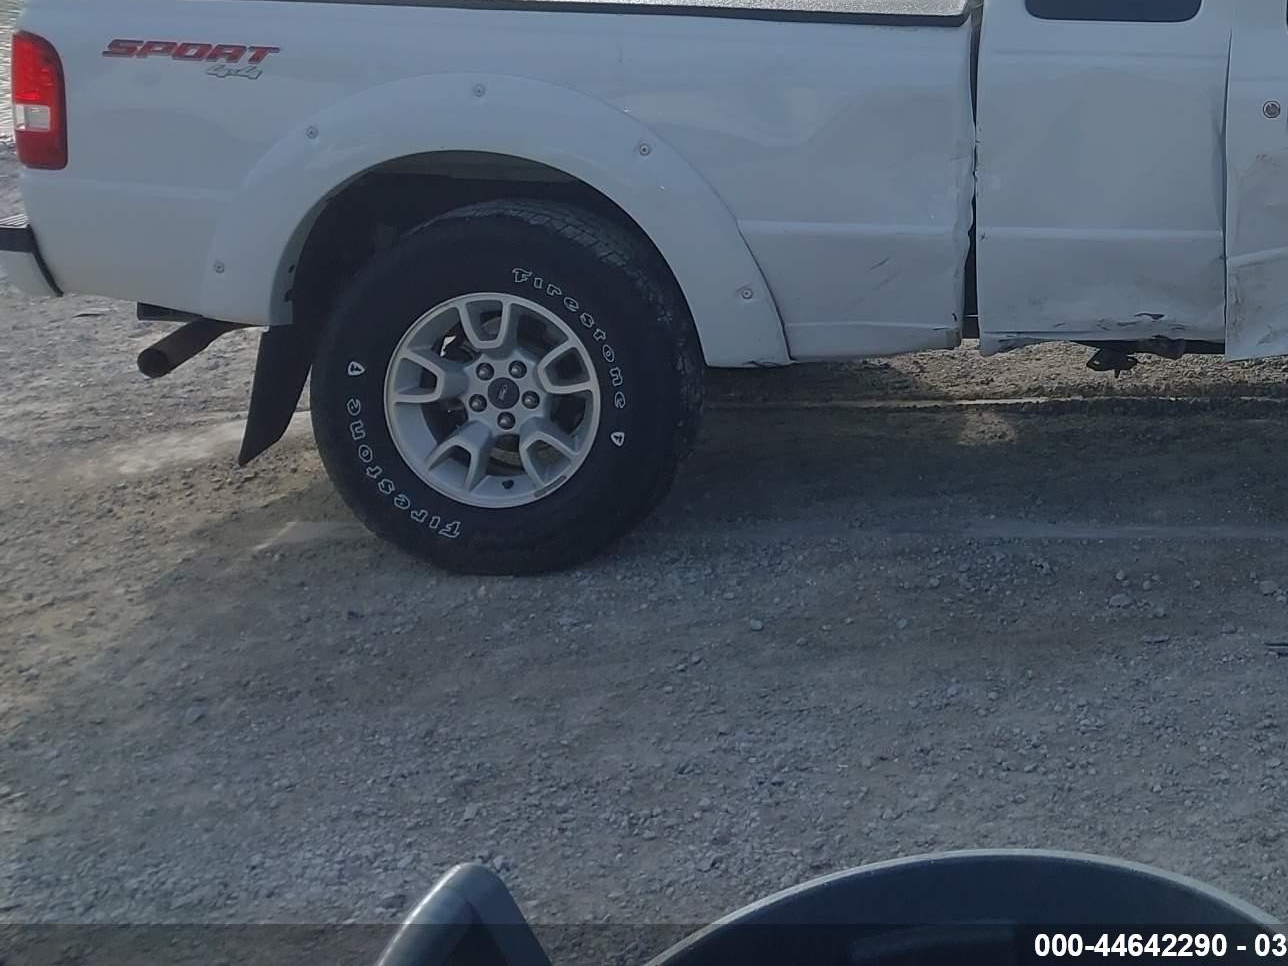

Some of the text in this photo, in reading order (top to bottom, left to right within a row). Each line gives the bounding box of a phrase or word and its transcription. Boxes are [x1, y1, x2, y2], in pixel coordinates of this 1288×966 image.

[102, 38, 281, 65] SPORT
[511, 267, 627, 410] Firestone
[346, 397, 461, 539] Firestone
